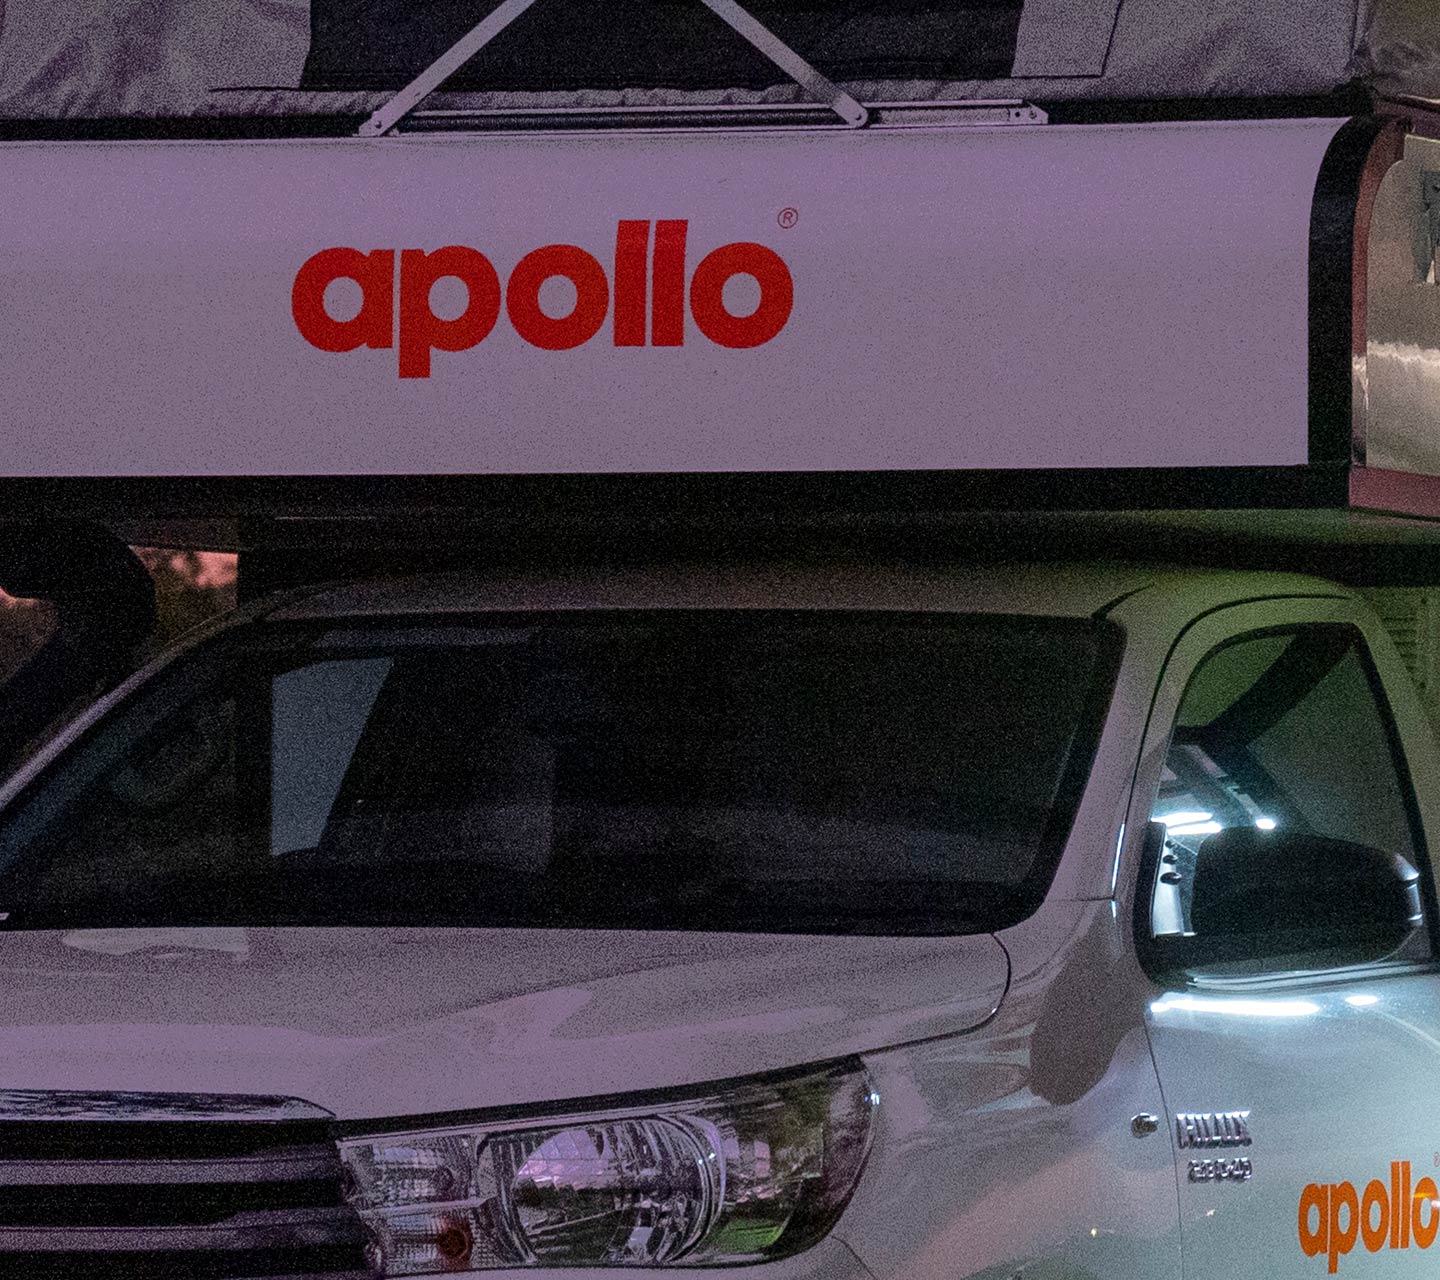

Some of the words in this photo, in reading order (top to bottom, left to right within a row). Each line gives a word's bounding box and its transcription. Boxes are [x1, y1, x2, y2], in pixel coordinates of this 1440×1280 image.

[291, 219, 794, 379] apollo
[1176, 1110, 1253, 1149] HILUX
[1298, 1160, 1440, 1274] apollo
